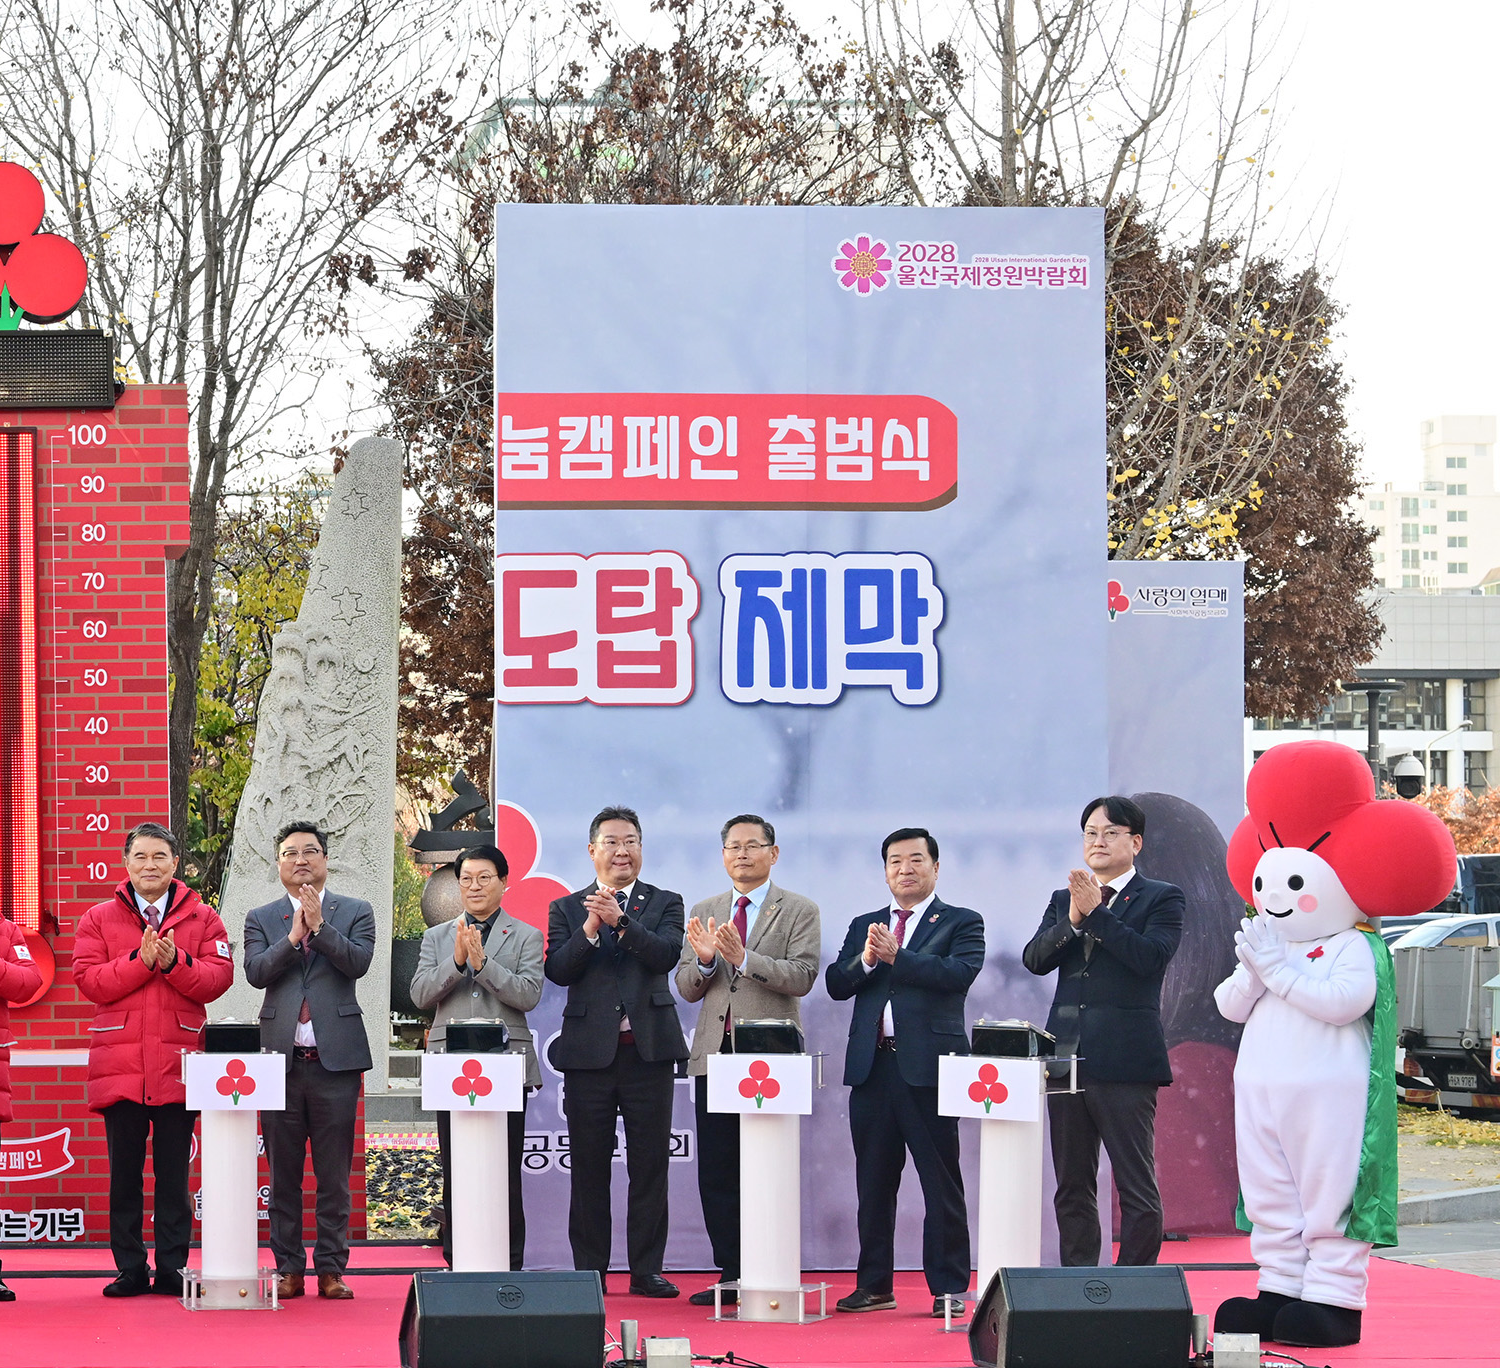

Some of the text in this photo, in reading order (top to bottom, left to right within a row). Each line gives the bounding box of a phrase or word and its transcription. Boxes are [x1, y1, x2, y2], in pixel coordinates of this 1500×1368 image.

[898, 243, 955, 263] 2028
[1072, 256, 1087, 264] Expo
[897, 265, 1088, 287] 울산국제정원박람회
[67, 424, 107, 446] 100
[500, 414, 930, 482] 눔캠페인 출범식
[80, 475, 105, 494] 90
[81, 523, 106, 542] 80
[81, 572, 106, 590] 70
[1133, 588, 1227, 607] 사랑의 열매
[82, 620, 108, 639] 60
[501, 566, 930, 691] 도탑 제막
[83, 669, 108, 687] 50
[84, 717, 109, 735] 40
[84, 765, 110, 783] 30
[85, 814, 110, 832] 20
[86, 862, 109, 880] 10
[33, 1212, 81, 1238] 기부
